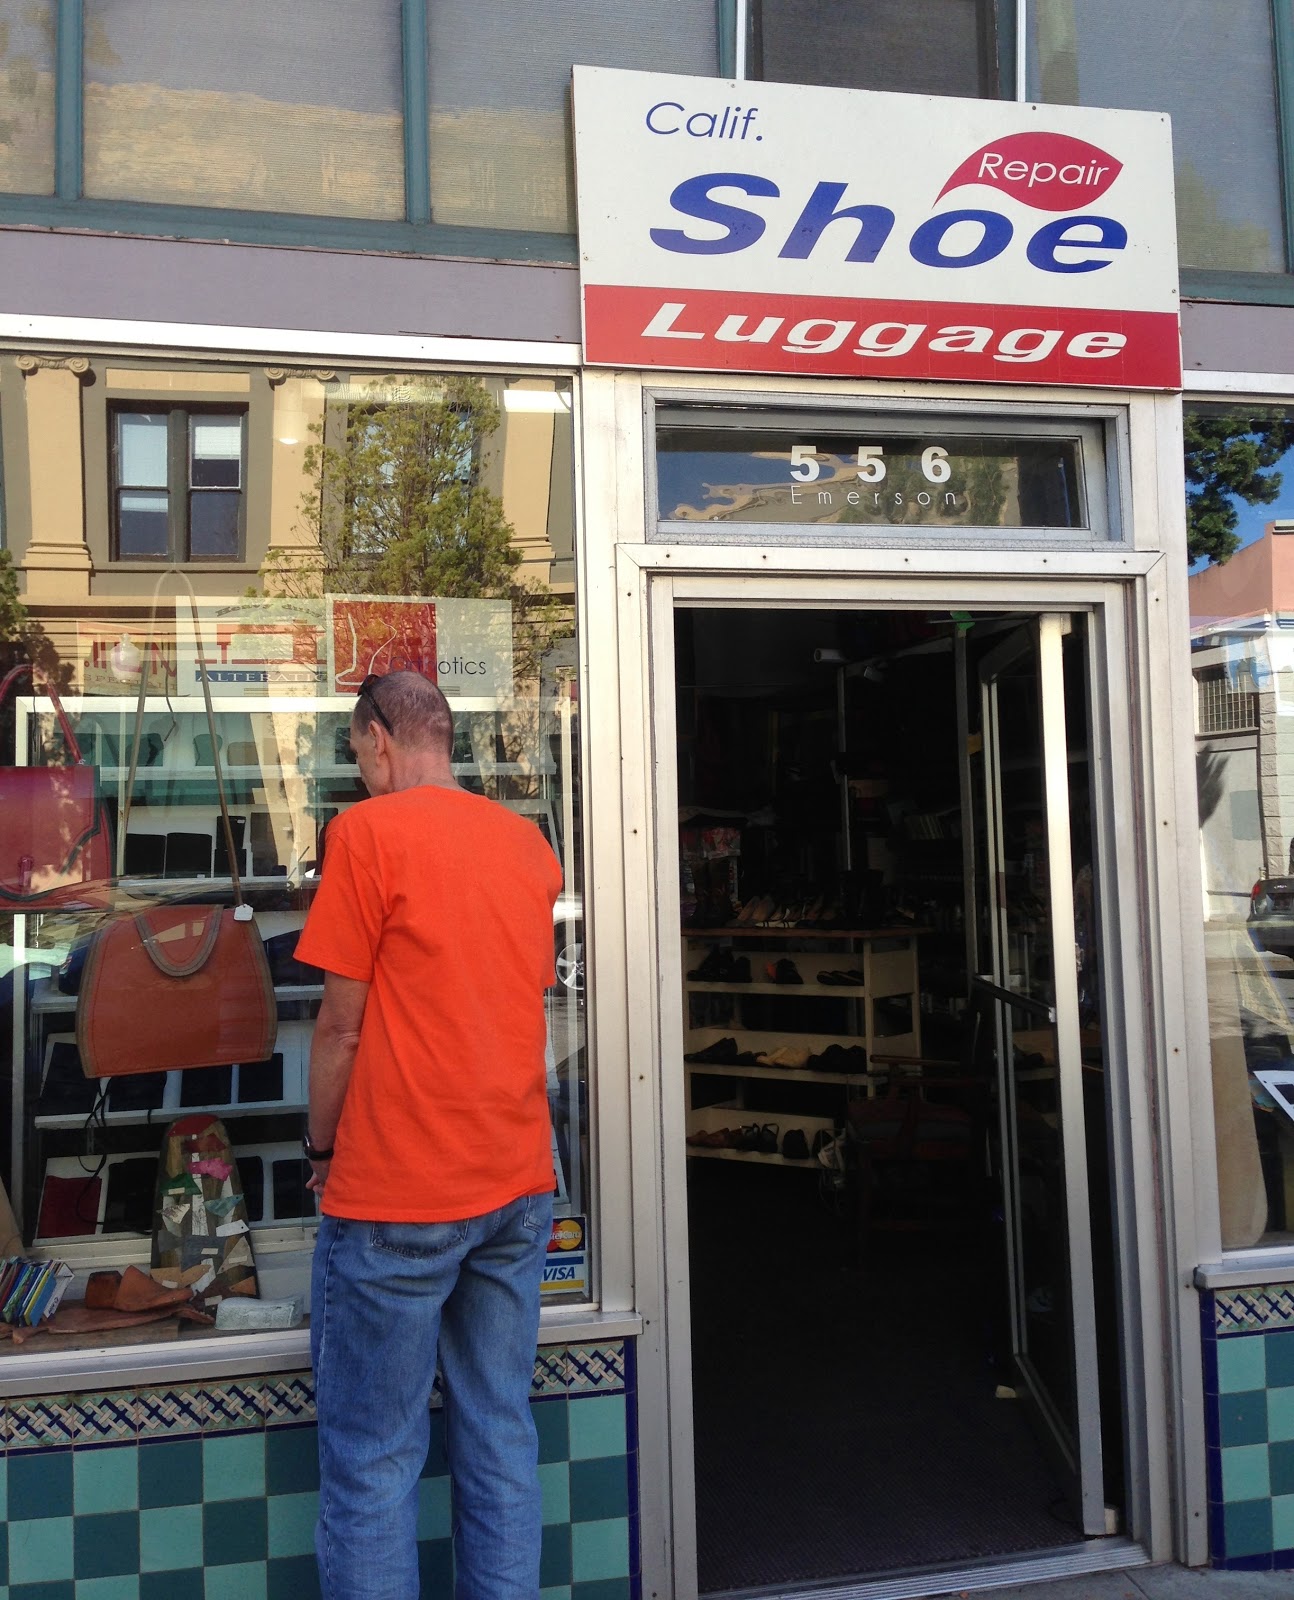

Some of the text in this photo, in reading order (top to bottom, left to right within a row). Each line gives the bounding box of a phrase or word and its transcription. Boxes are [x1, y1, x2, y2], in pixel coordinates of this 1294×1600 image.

[645, 101, 764, 142] Calif.
[977, 152, 1111, 189] Repair
[649, 171, 1129, 274] Shoe
[640, 301, 1128, 363] Luggage
[791, 485, 957, 506] Emerson
[543, 1266, 576, 1281] VISA
